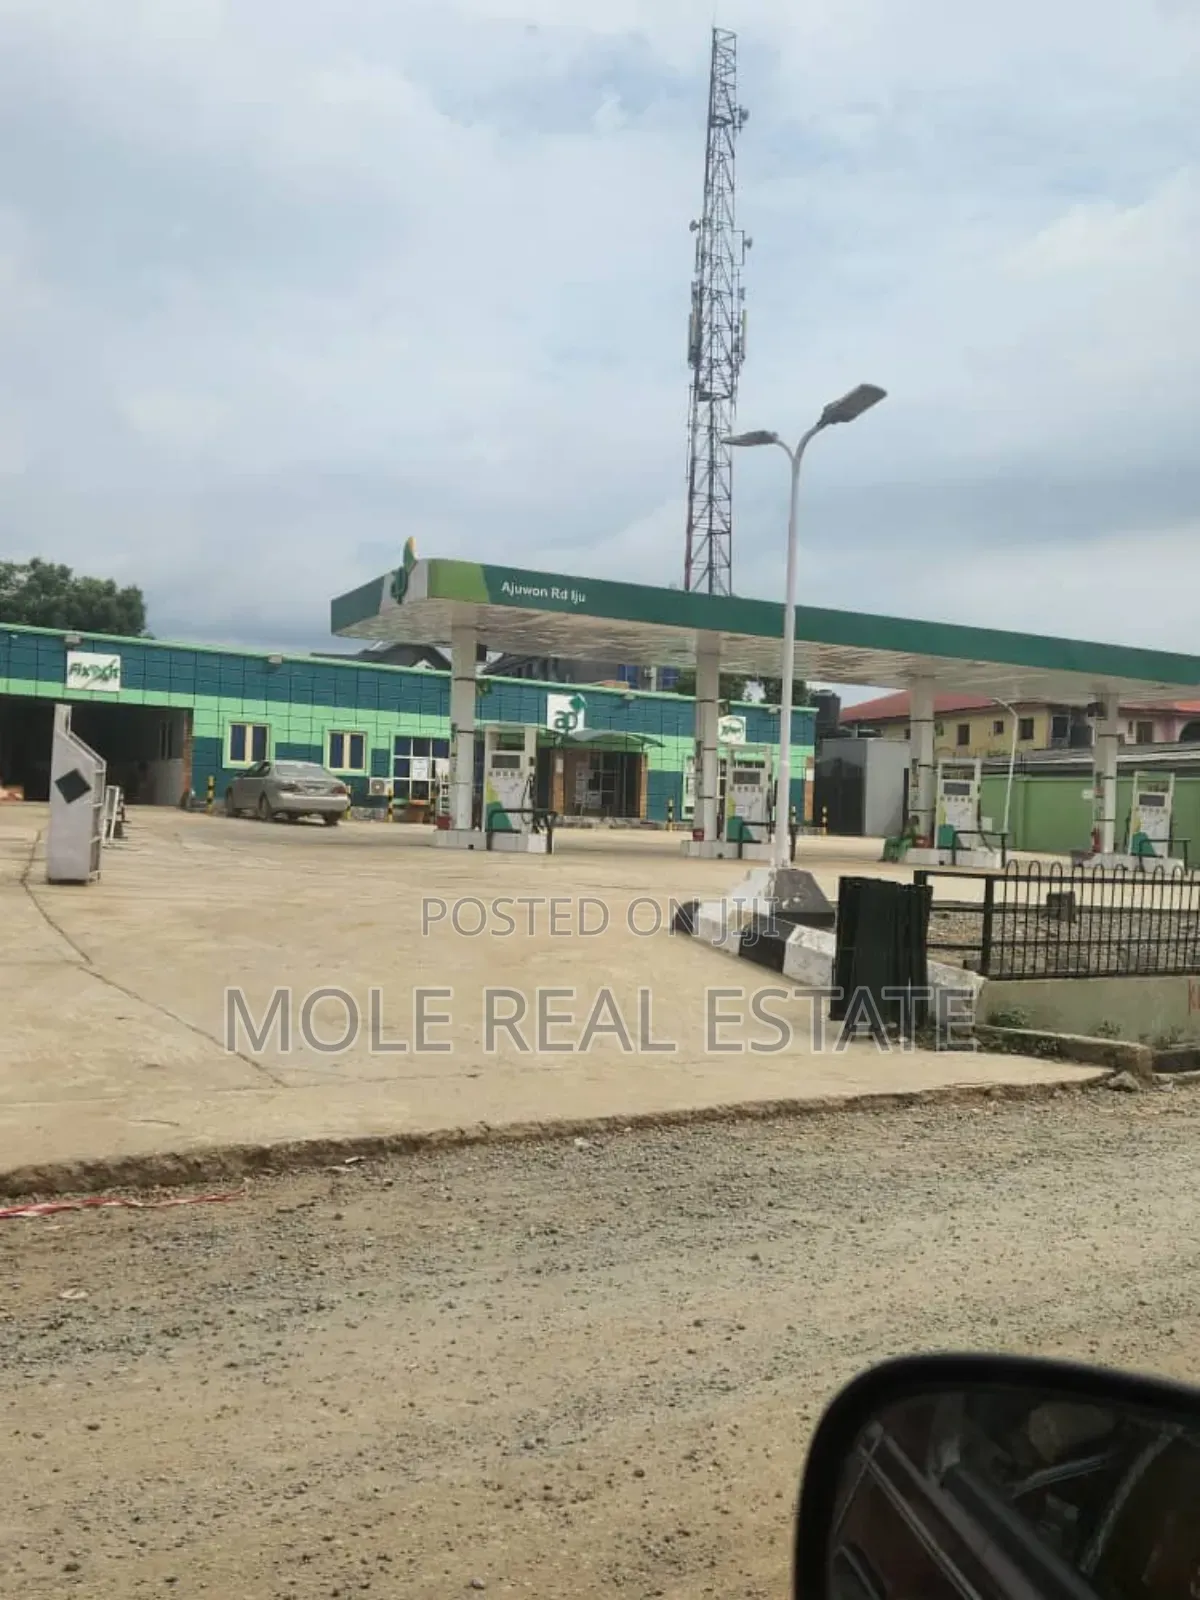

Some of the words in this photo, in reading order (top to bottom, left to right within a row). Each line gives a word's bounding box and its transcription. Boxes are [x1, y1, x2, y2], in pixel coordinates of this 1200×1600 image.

[501, 581, 548, 597] Ajuwon
[551, 586, 568, 600] Rd
[571, 589, 586, 605] Iju
